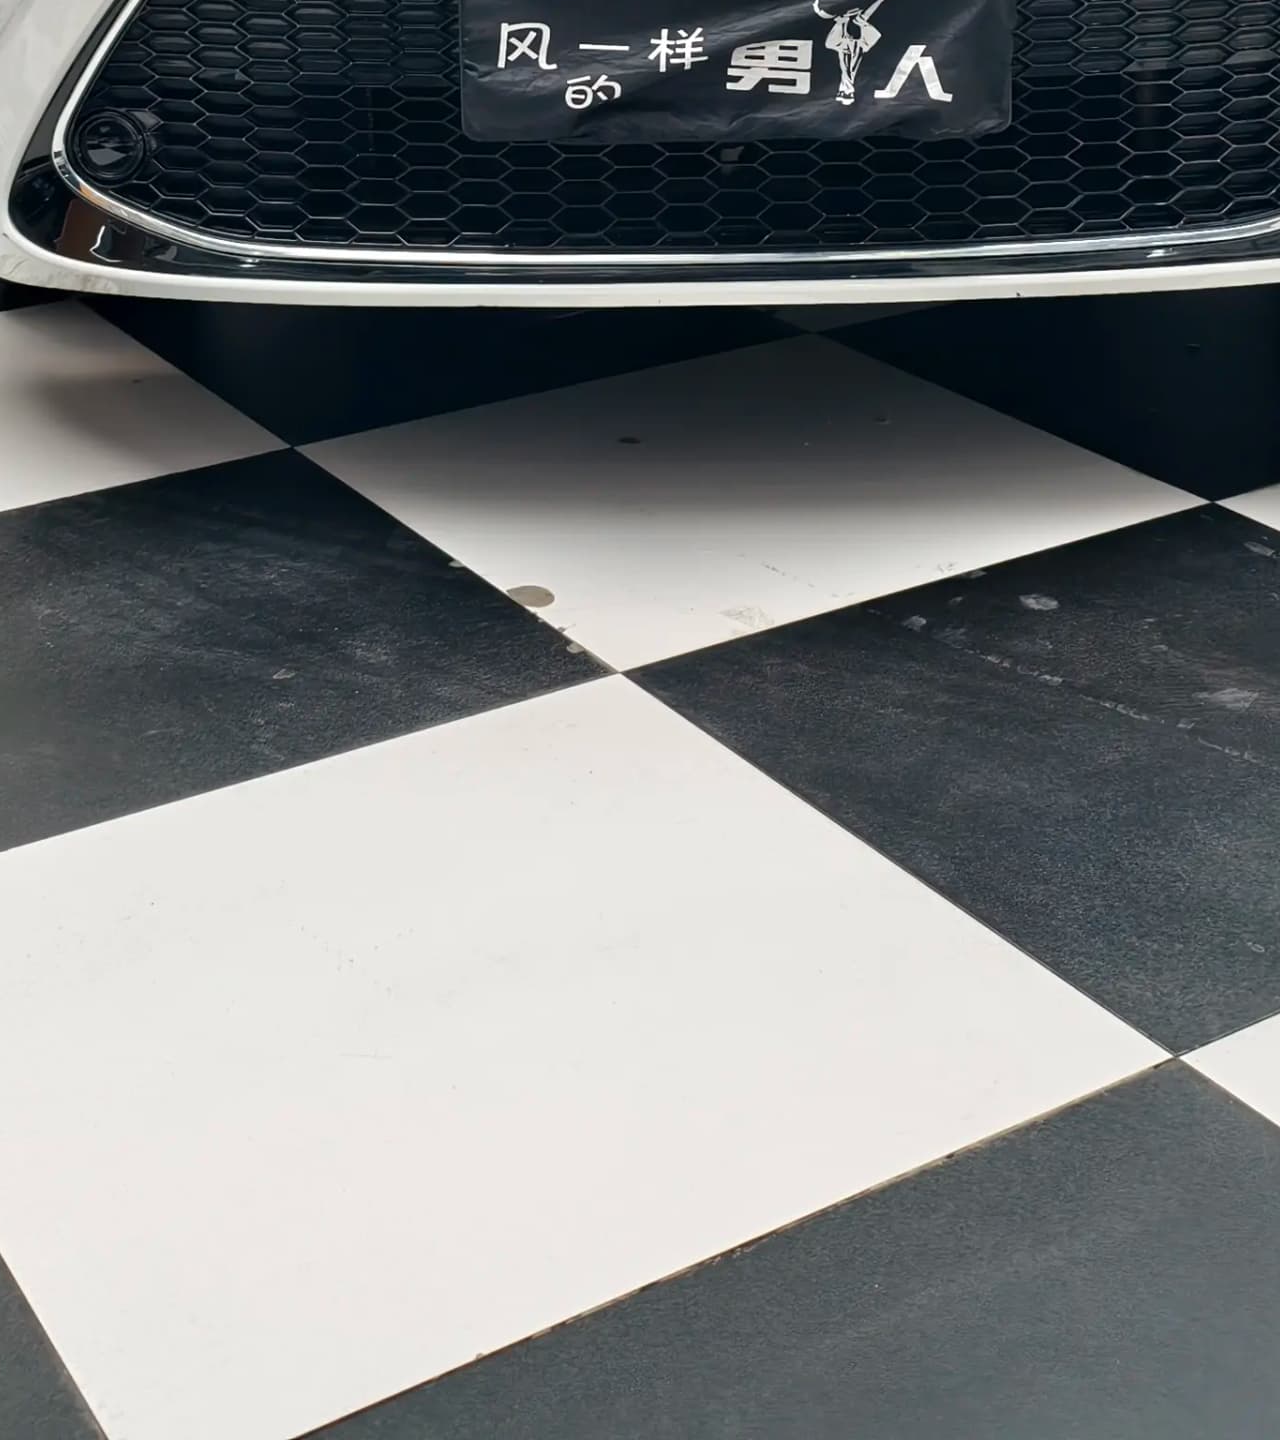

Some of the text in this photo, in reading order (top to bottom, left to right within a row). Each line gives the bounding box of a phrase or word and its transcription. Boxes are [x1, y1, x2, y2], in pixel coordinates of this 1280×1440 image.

[497, 22, 709, 72] 风一样
[564, 74, 622, 109] 的
